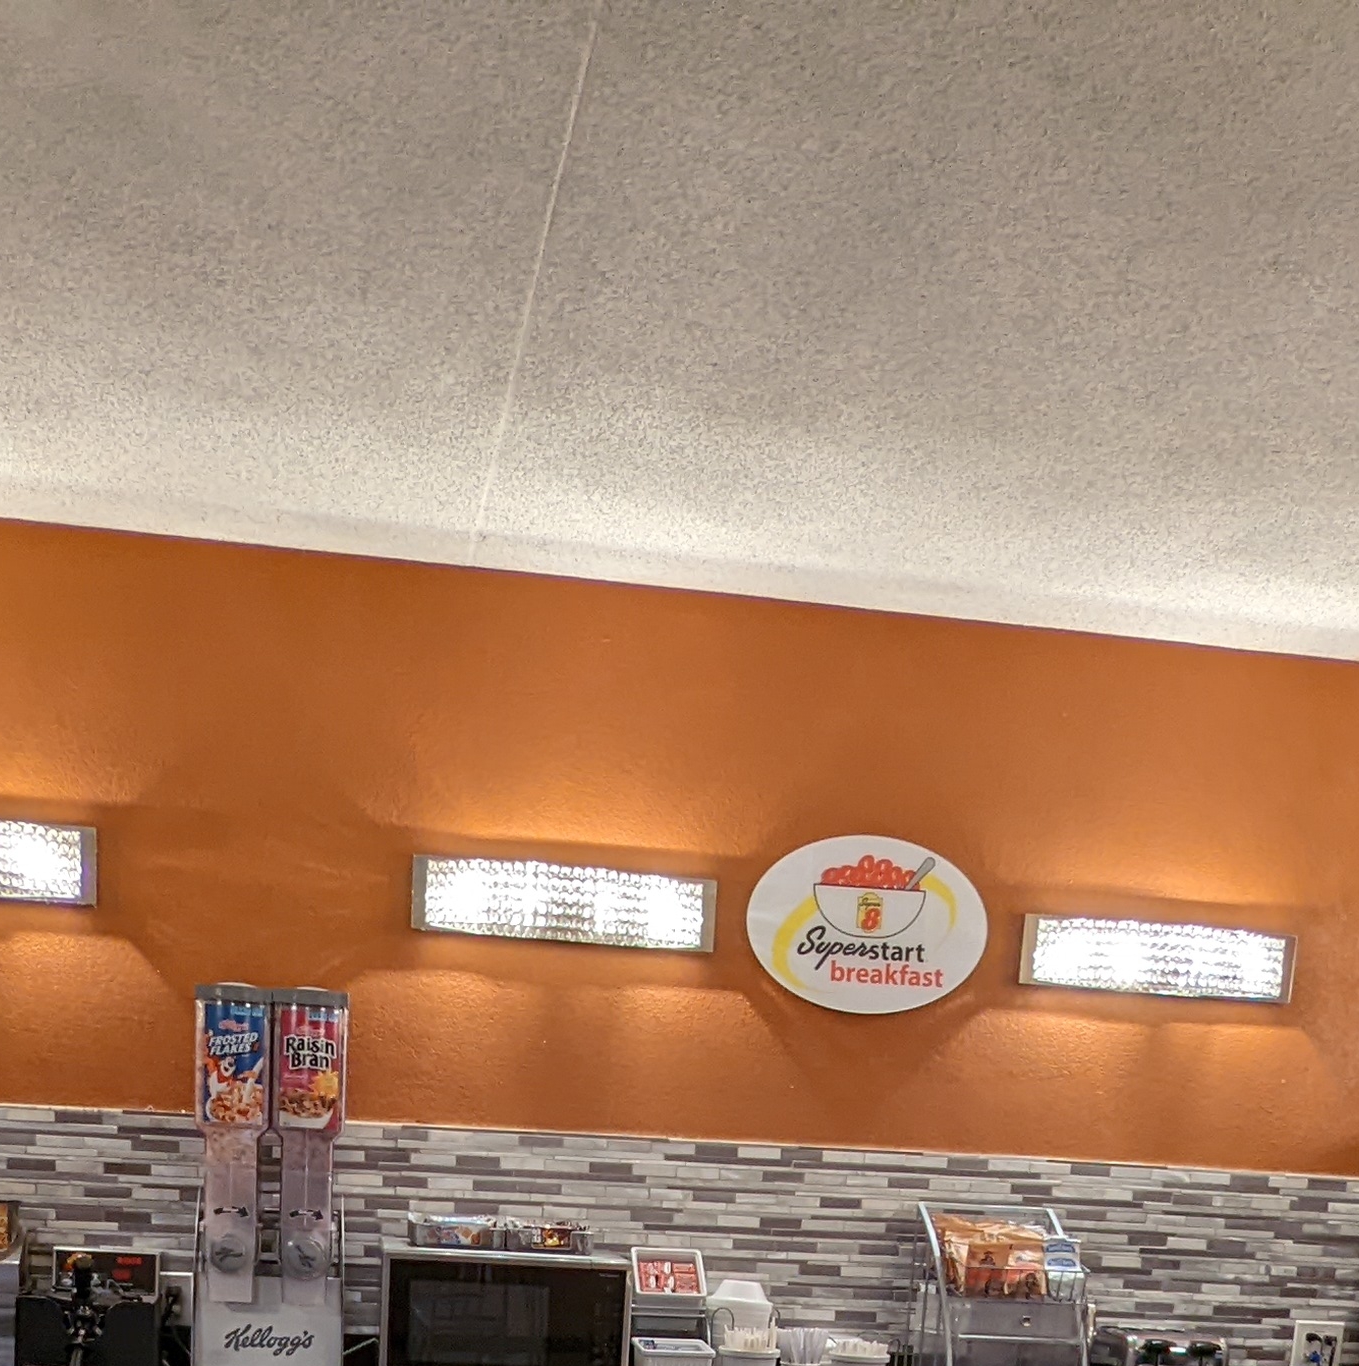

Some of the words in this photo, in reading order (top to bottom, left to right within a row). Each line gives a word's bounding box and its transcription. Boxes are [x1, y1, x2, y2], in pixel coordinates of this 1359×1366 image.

[861, 908, 881, 932] 8
[796, 925, 926, 970] Superstart
[830, 960, 944, 988] breakfast
[208, 1031, 259, 1047] FROSTED
[210, 1042, 252, 1056] FLAKES
[285, 1035, 336, 1058] Raisin
[290, 1051, 330, 1069] Bran
[224, 1323, 315, 1357] Kellogg's
